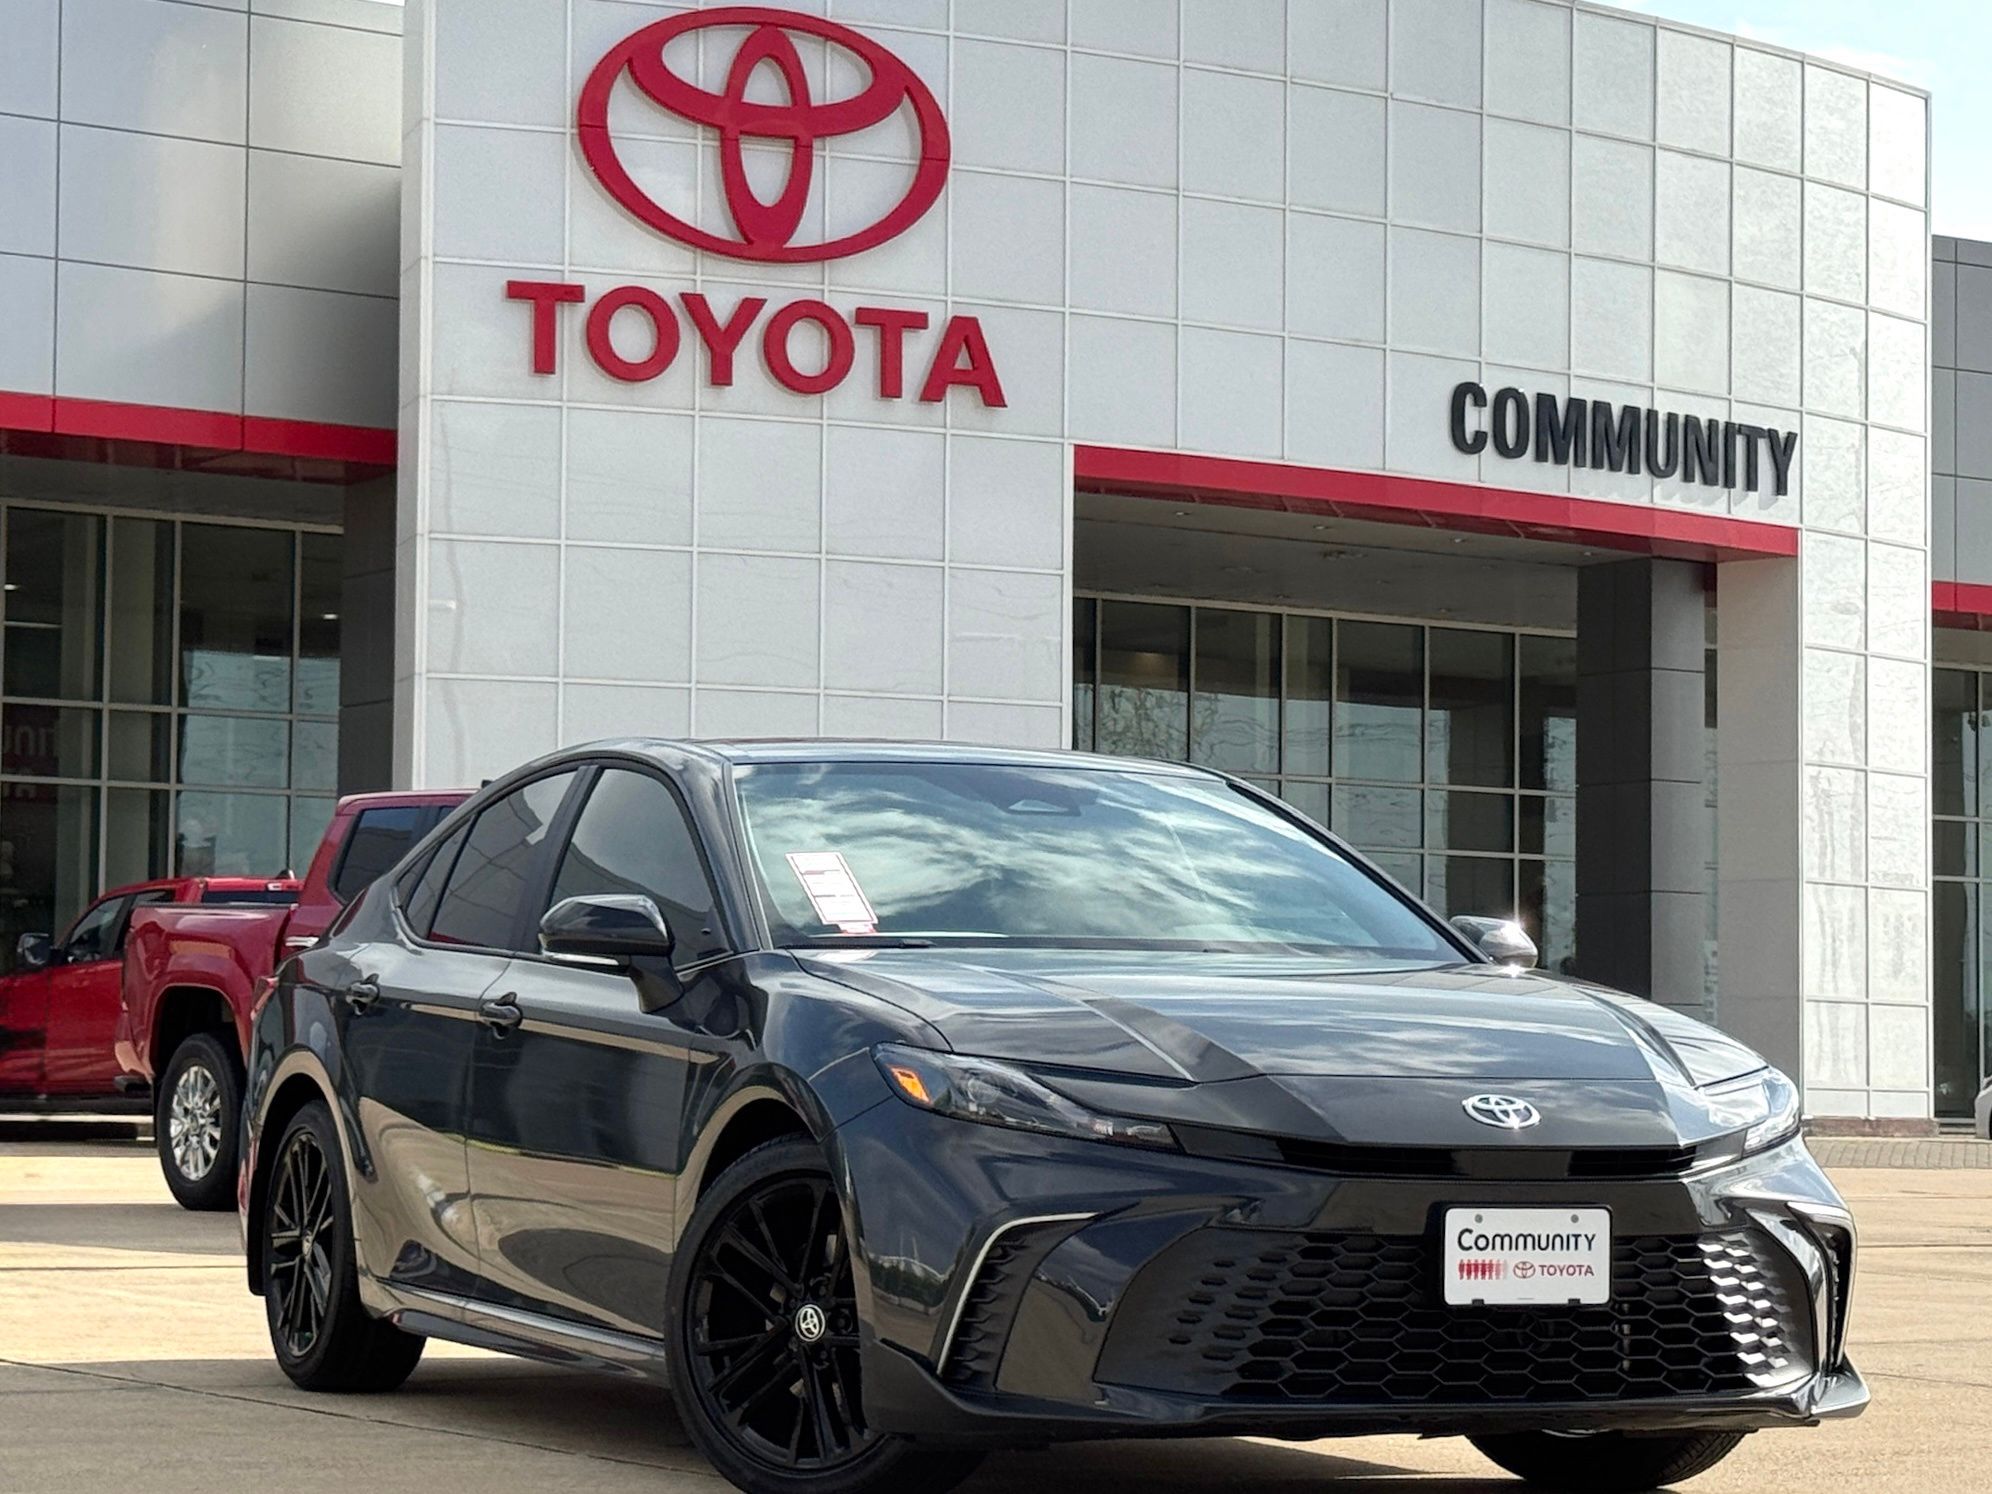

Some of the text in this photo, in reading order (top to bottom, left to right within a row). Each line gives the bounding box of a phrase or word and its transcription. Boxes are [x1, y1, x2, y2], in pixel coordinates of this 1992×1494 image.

[507, 280, 1008, 408] TOYOTA
[1450, 381, 1798, 497] COMMUNITY
[1538, 1264, 1595, 1277] TOYOTA
